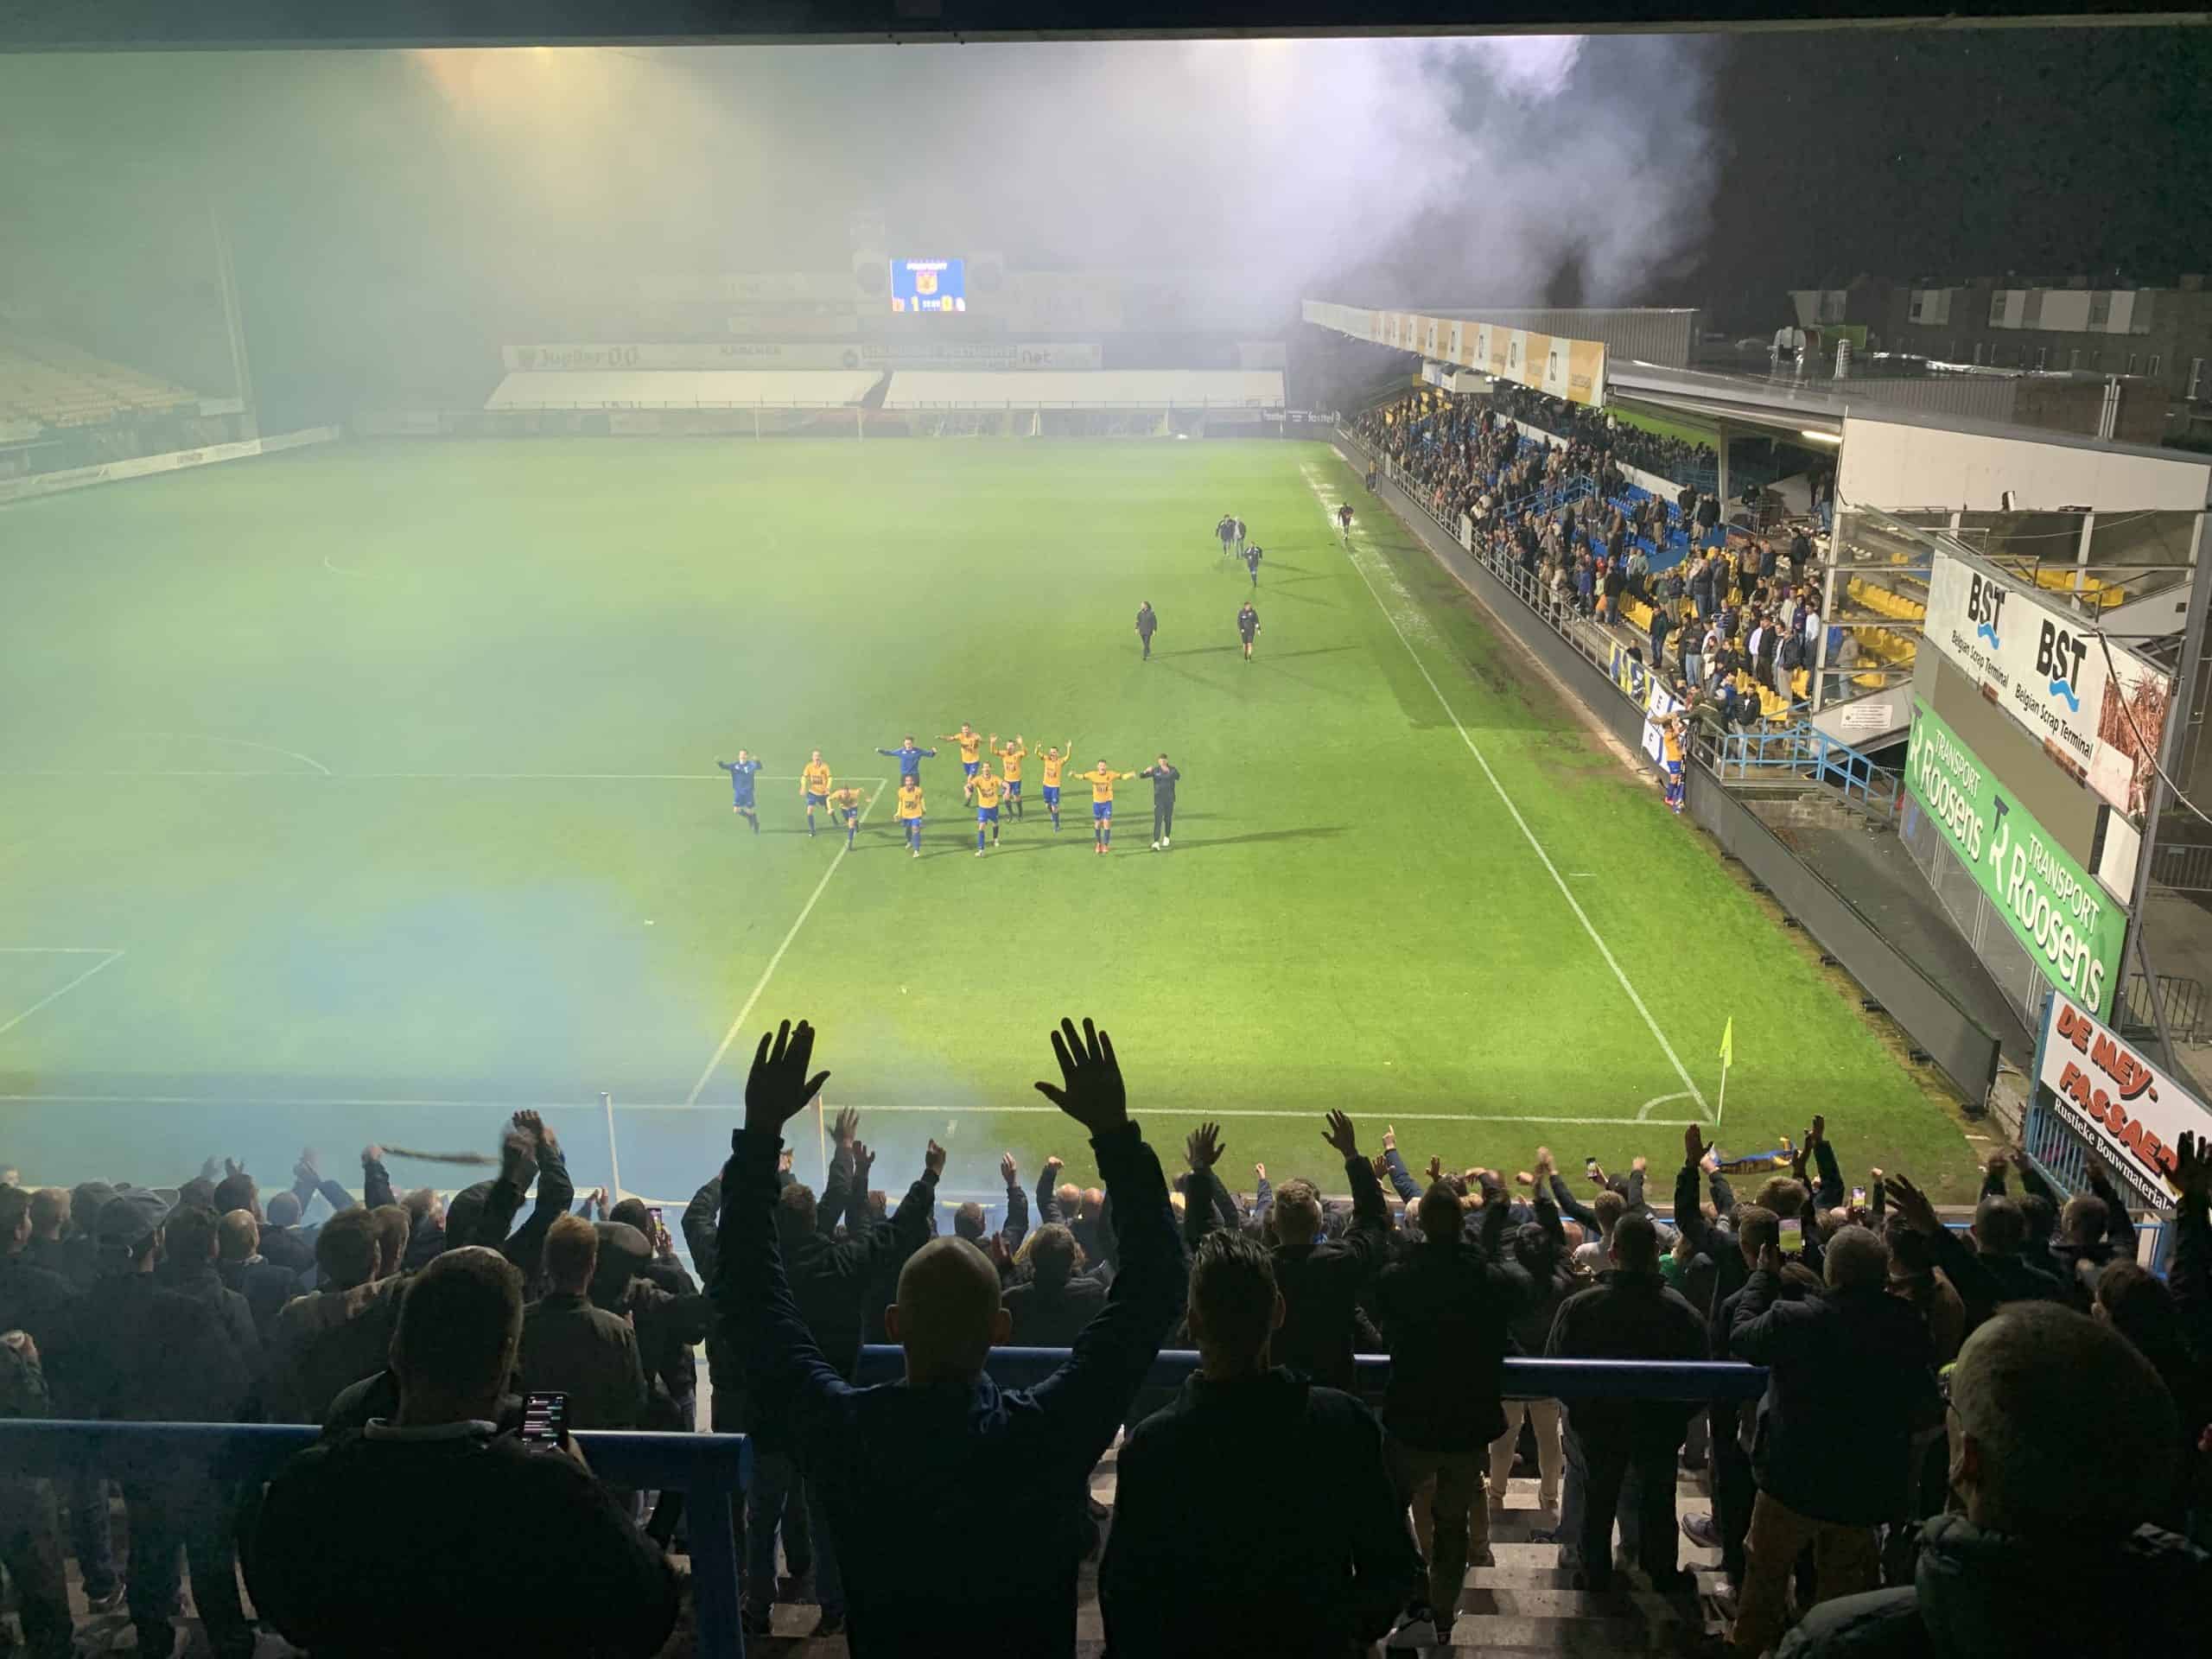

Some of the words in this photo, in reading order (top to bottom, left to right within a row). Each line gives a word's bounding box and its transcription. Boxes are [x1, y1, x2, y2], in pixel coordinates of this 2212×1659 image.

[1968, 573, 2005, 634] BST
[1952, 630, 1970, 654] Belgian
[1970, 645, 1985, 671] Scrap
[1985, 657, 2010, 688] Terminal
[2037, 619, 2088, 695] BST
[2015, 683, 2039, 715] Belgian
[2040, 704, 2060, 734] Scrap
[2060, 719, 2094, 760] Terminal
[1935, 728, 1981, 798] TRANSPORT
[1920, 739, 1983, 861] Roosens
[2030, 831, 2100, 934] TRANSPORT
[2006, 842, 2104, 1014] Roosens
[2056, 1004, 2093, 1055] DE
[2054, 1097, 2096, 1146] Rustieke
